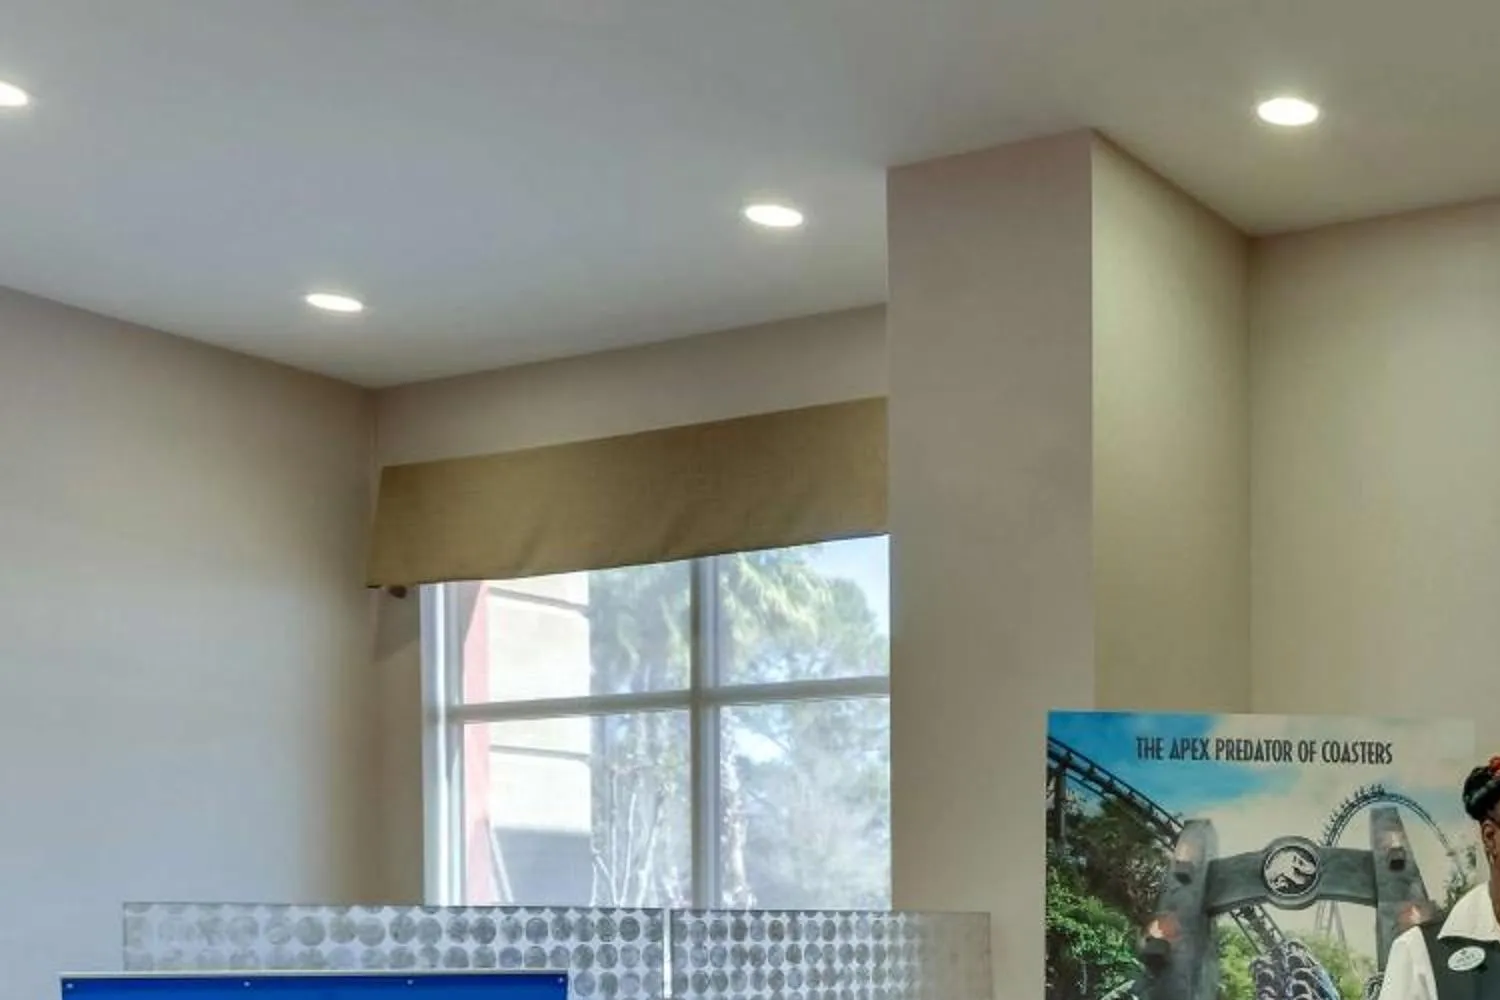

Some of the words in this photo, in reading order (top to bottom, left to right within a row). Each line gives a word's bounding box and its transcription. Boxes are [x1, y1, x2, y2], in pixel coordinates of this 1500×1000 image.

[1136, 737, 1164, 761] THE
[1169, 737, 1210, 762] APEX
[1215, 738, 1293, 763] PREDATOR
[1298, 740, 1317, 763] OF
[1321, 740, 1393, 765] COASTERS
